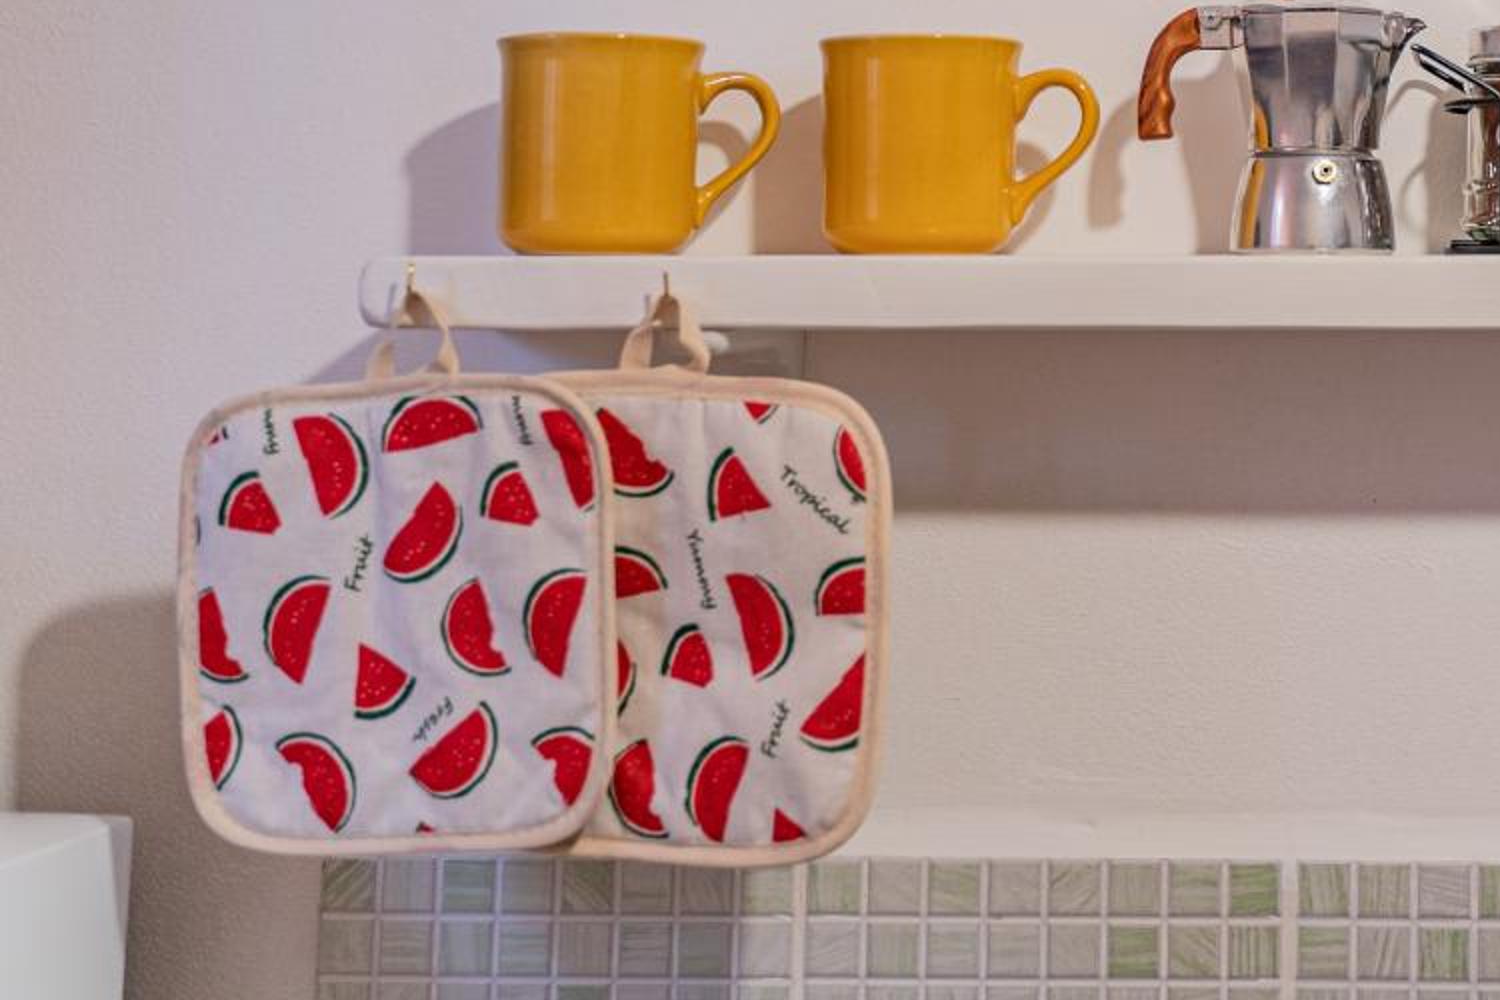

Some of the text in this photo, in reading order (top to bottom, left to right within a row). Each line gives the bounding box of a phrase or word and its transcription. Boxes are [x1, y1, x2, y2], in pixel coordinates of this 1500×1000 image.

[780, 464, 851, 535] Tropical
[343, 533, 374, 592] Fruit
[685, 528, 718, 610] Yummy
[760, 698, 790, 759] Fruit
